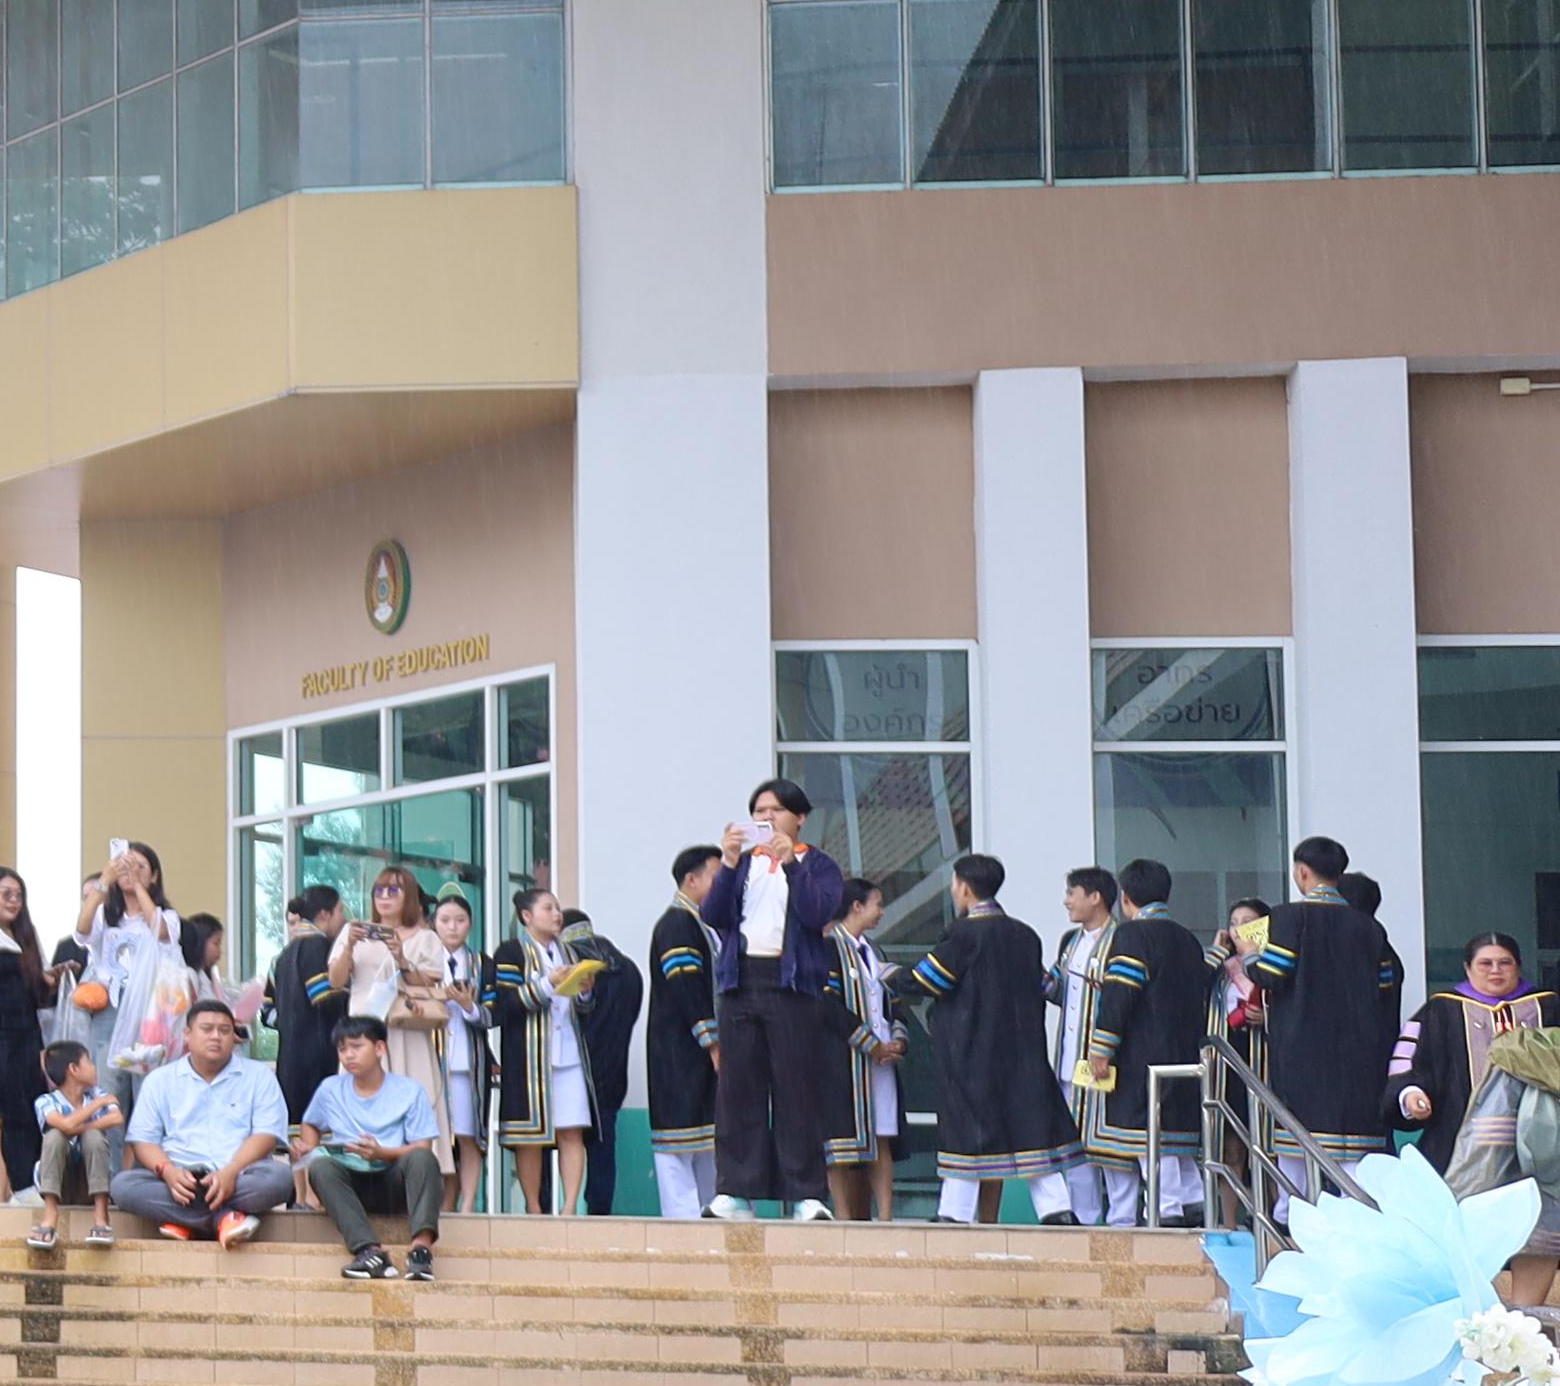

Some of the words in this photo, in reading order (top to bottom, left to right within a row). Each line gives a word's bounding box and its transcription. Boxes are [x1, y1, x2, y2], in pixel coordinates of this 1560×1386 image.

[301, 661, 369, 698] FACULTY
[374, 655, 394, 682] OF
[397, 633, 490, 678] EDUCATION
